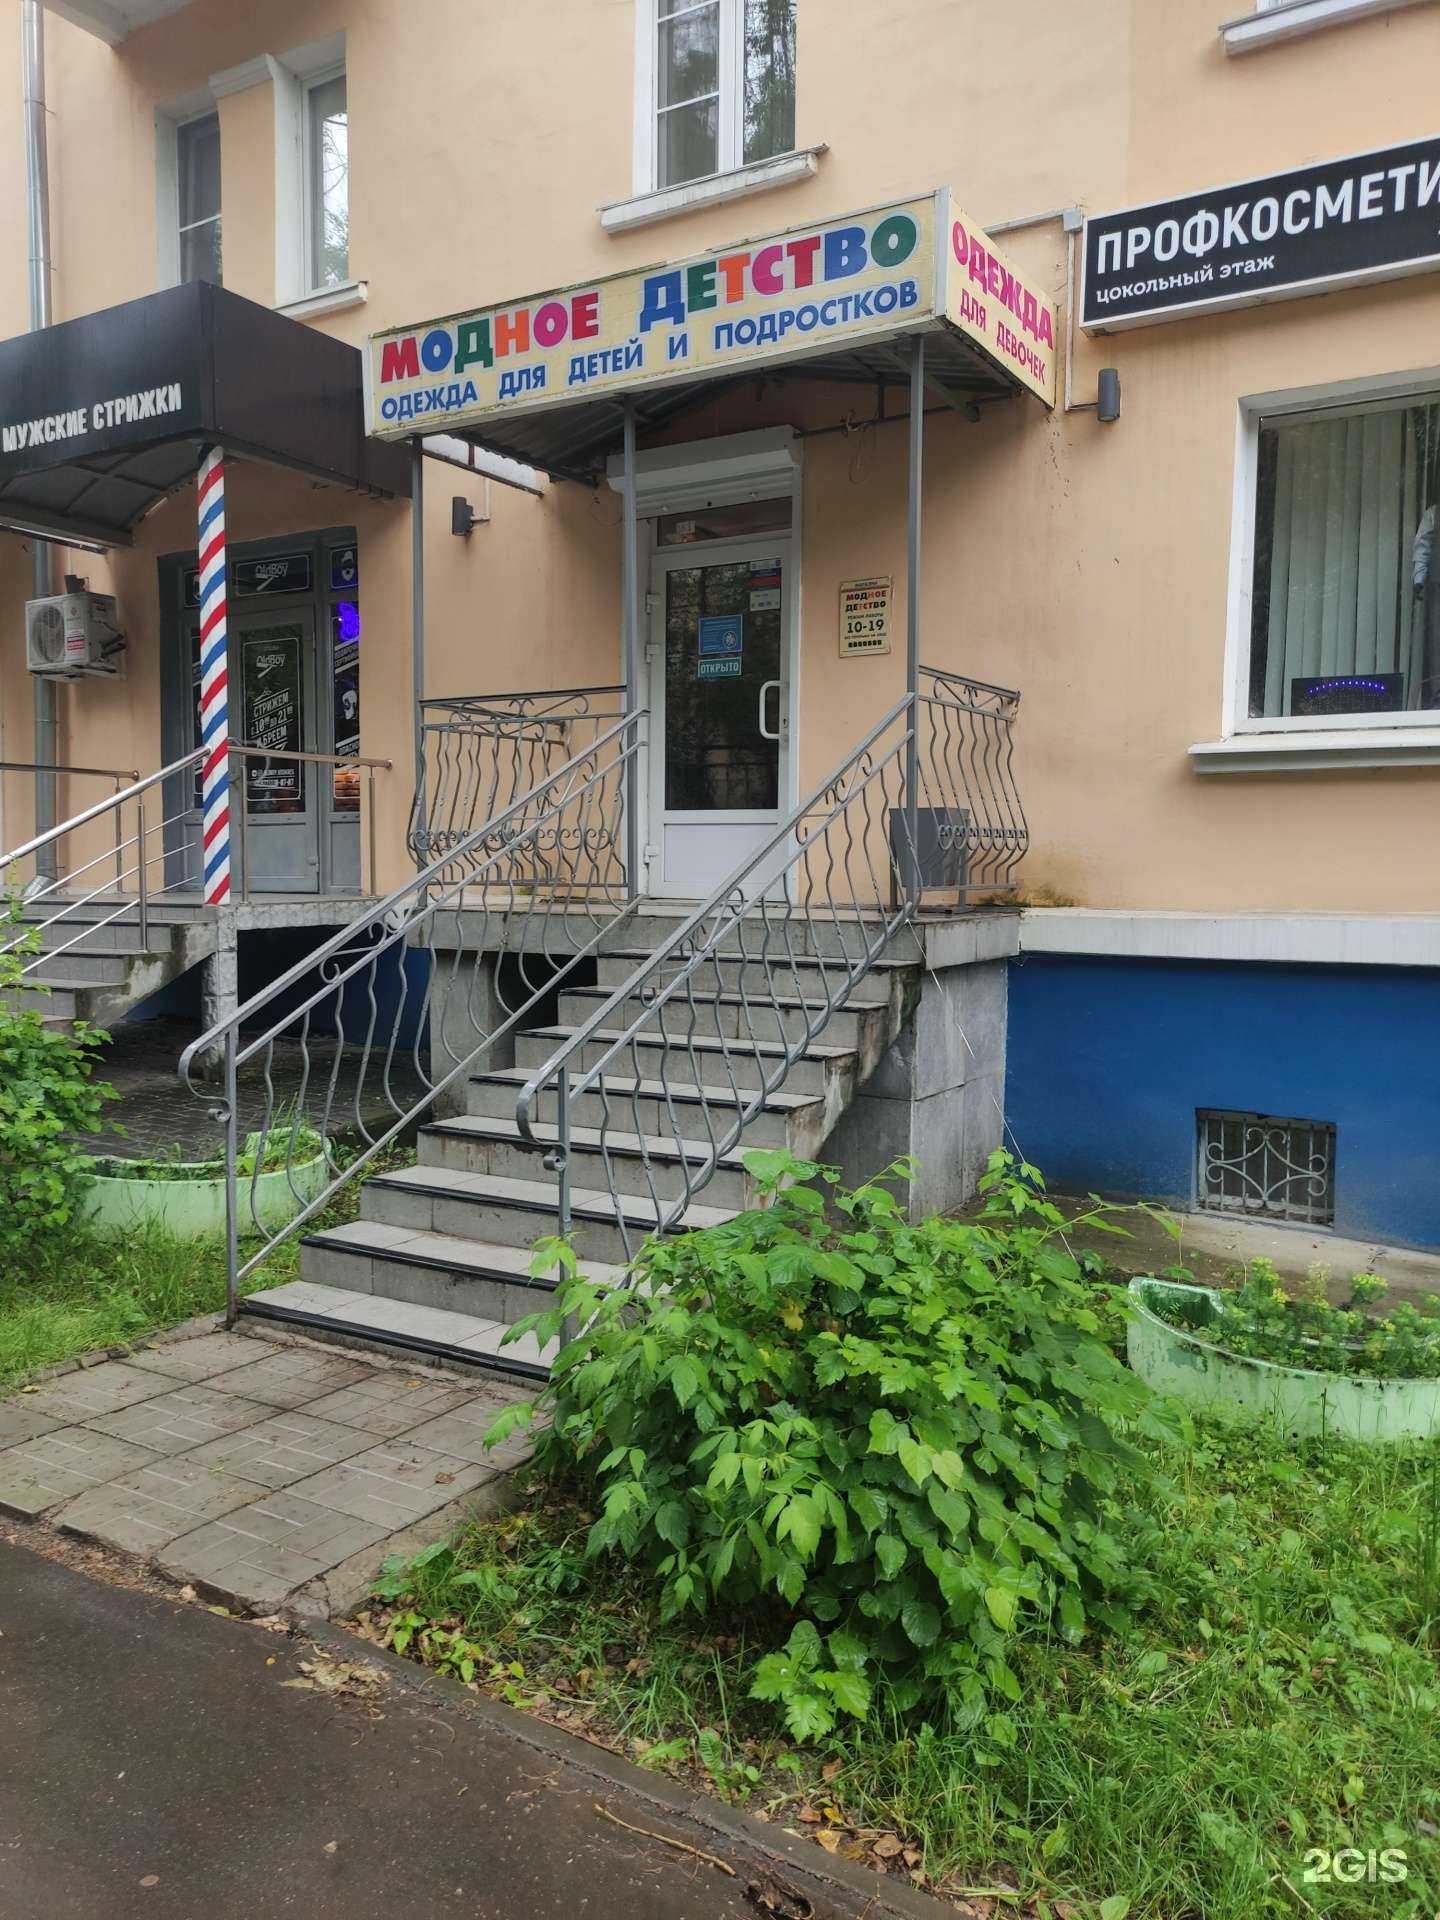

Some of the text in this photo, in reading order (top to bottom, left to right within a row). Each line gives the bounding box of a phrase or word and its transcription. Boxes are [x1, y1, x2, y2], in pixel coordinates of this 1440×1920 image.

[1097, 160, 1440, 274] ПРОФКОСМЕТИ
[381, 215, 917, 383] МОДНОЕ ДЕТСТВО
[952, 220, 1053, 350] ОДЕЖДА
[1096, 255, 1275, 303] цокольный этаж
[381, 280, 918, 420] ОДЕЖДА ДЛЯ ДЕТЕЙ И ПОДРОСТКОВ
[960, 288, 1045, 384] ДЛЯ ДЕВОЧЕК
[2, 383, 182, 452] МУЖСКИЕ СТРИЖКИ
[845, 600, 886, 612] ДЕТСТВО
[846, 590, 887, 601] МОДНОЕ
[848, 619, 884, 633] 10-19
[700, 662, 739, 675] ОТКРЫТО
[253, 692, 289, 718] СТРИЖЕМ
[262, 725, 287, 747] БРЕЕМ
